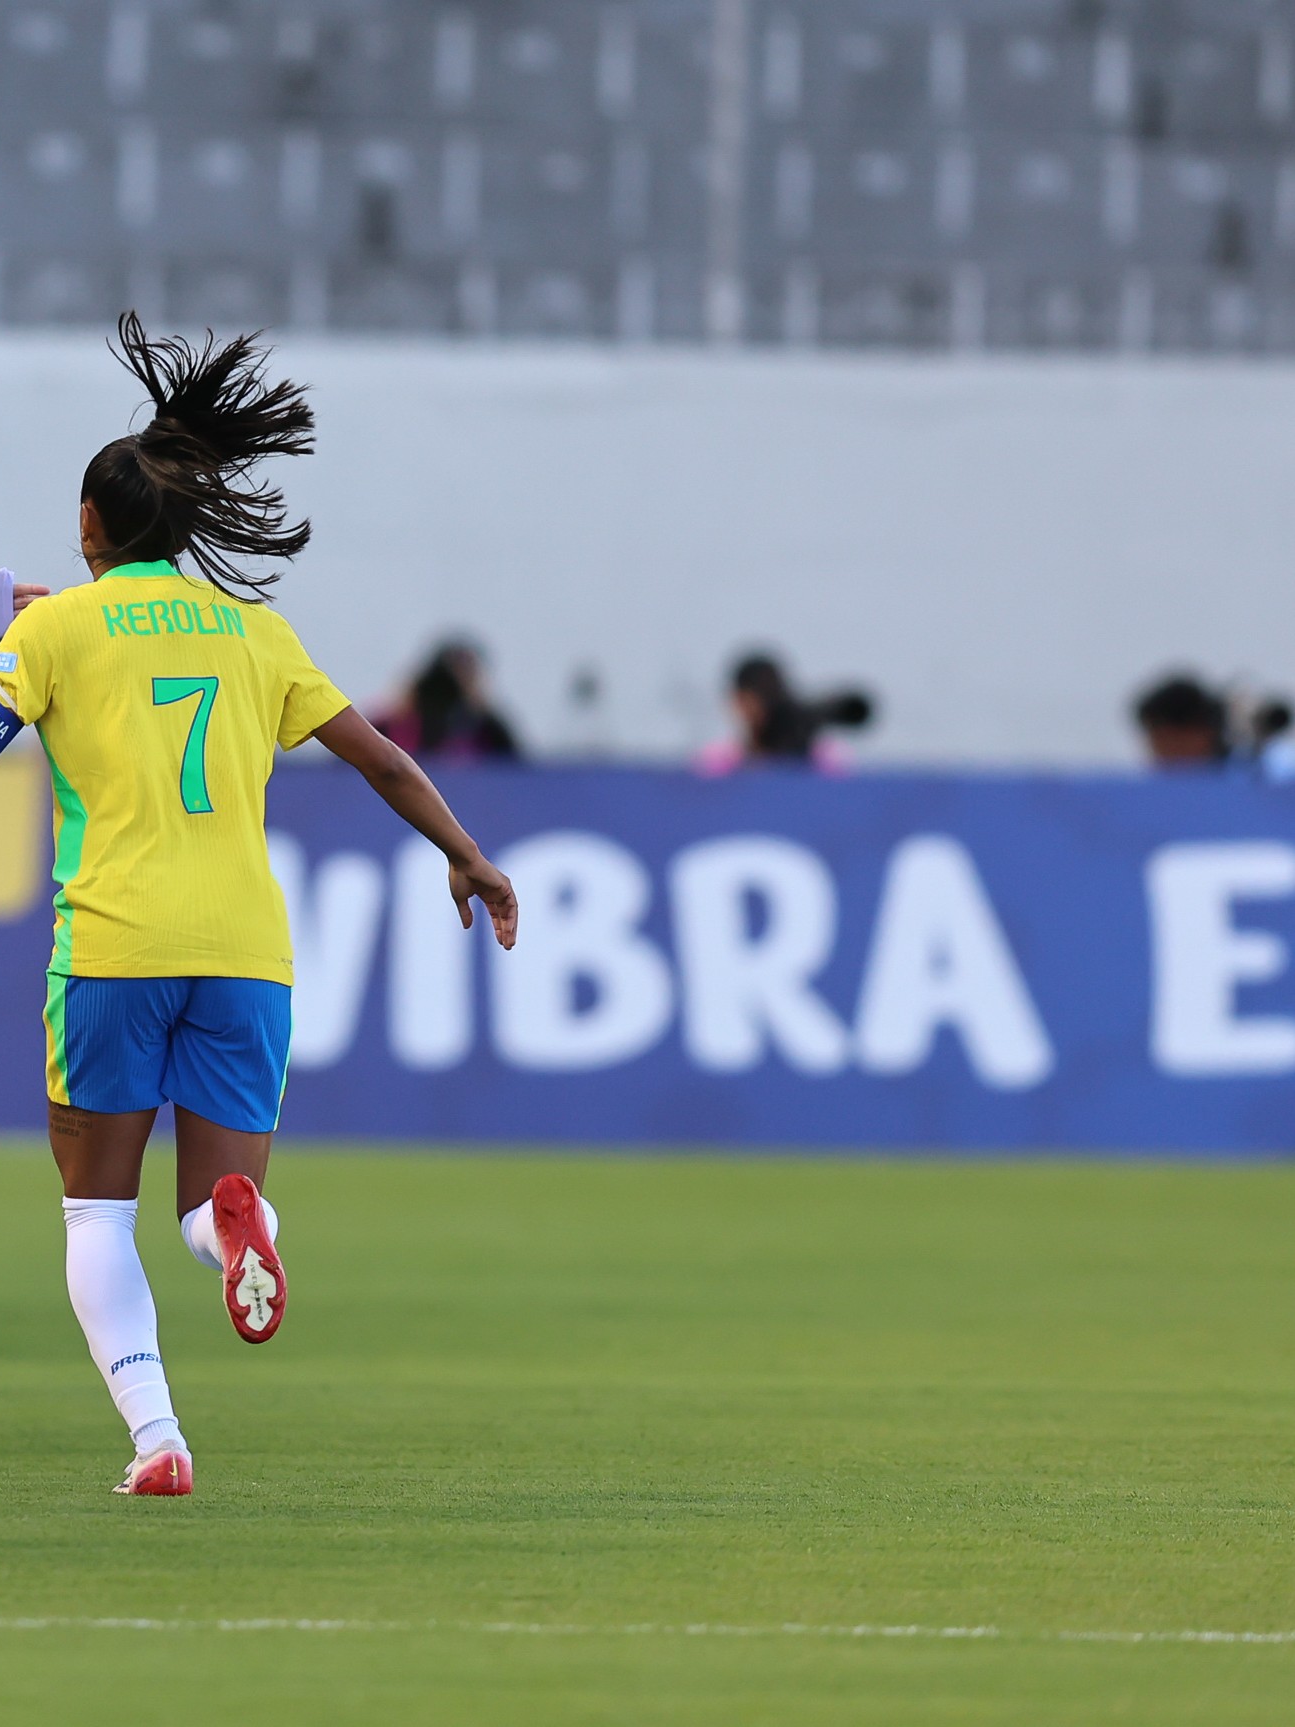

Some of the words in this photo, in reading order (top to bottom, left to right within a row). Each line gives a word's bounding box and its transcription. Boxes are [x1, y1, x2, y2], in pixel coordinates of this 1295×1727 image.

[102, 599, 246, 639] KEROLIN
[152, 676, 220, 814] 7
[268, 828, 1054, 1090] VIBRA
